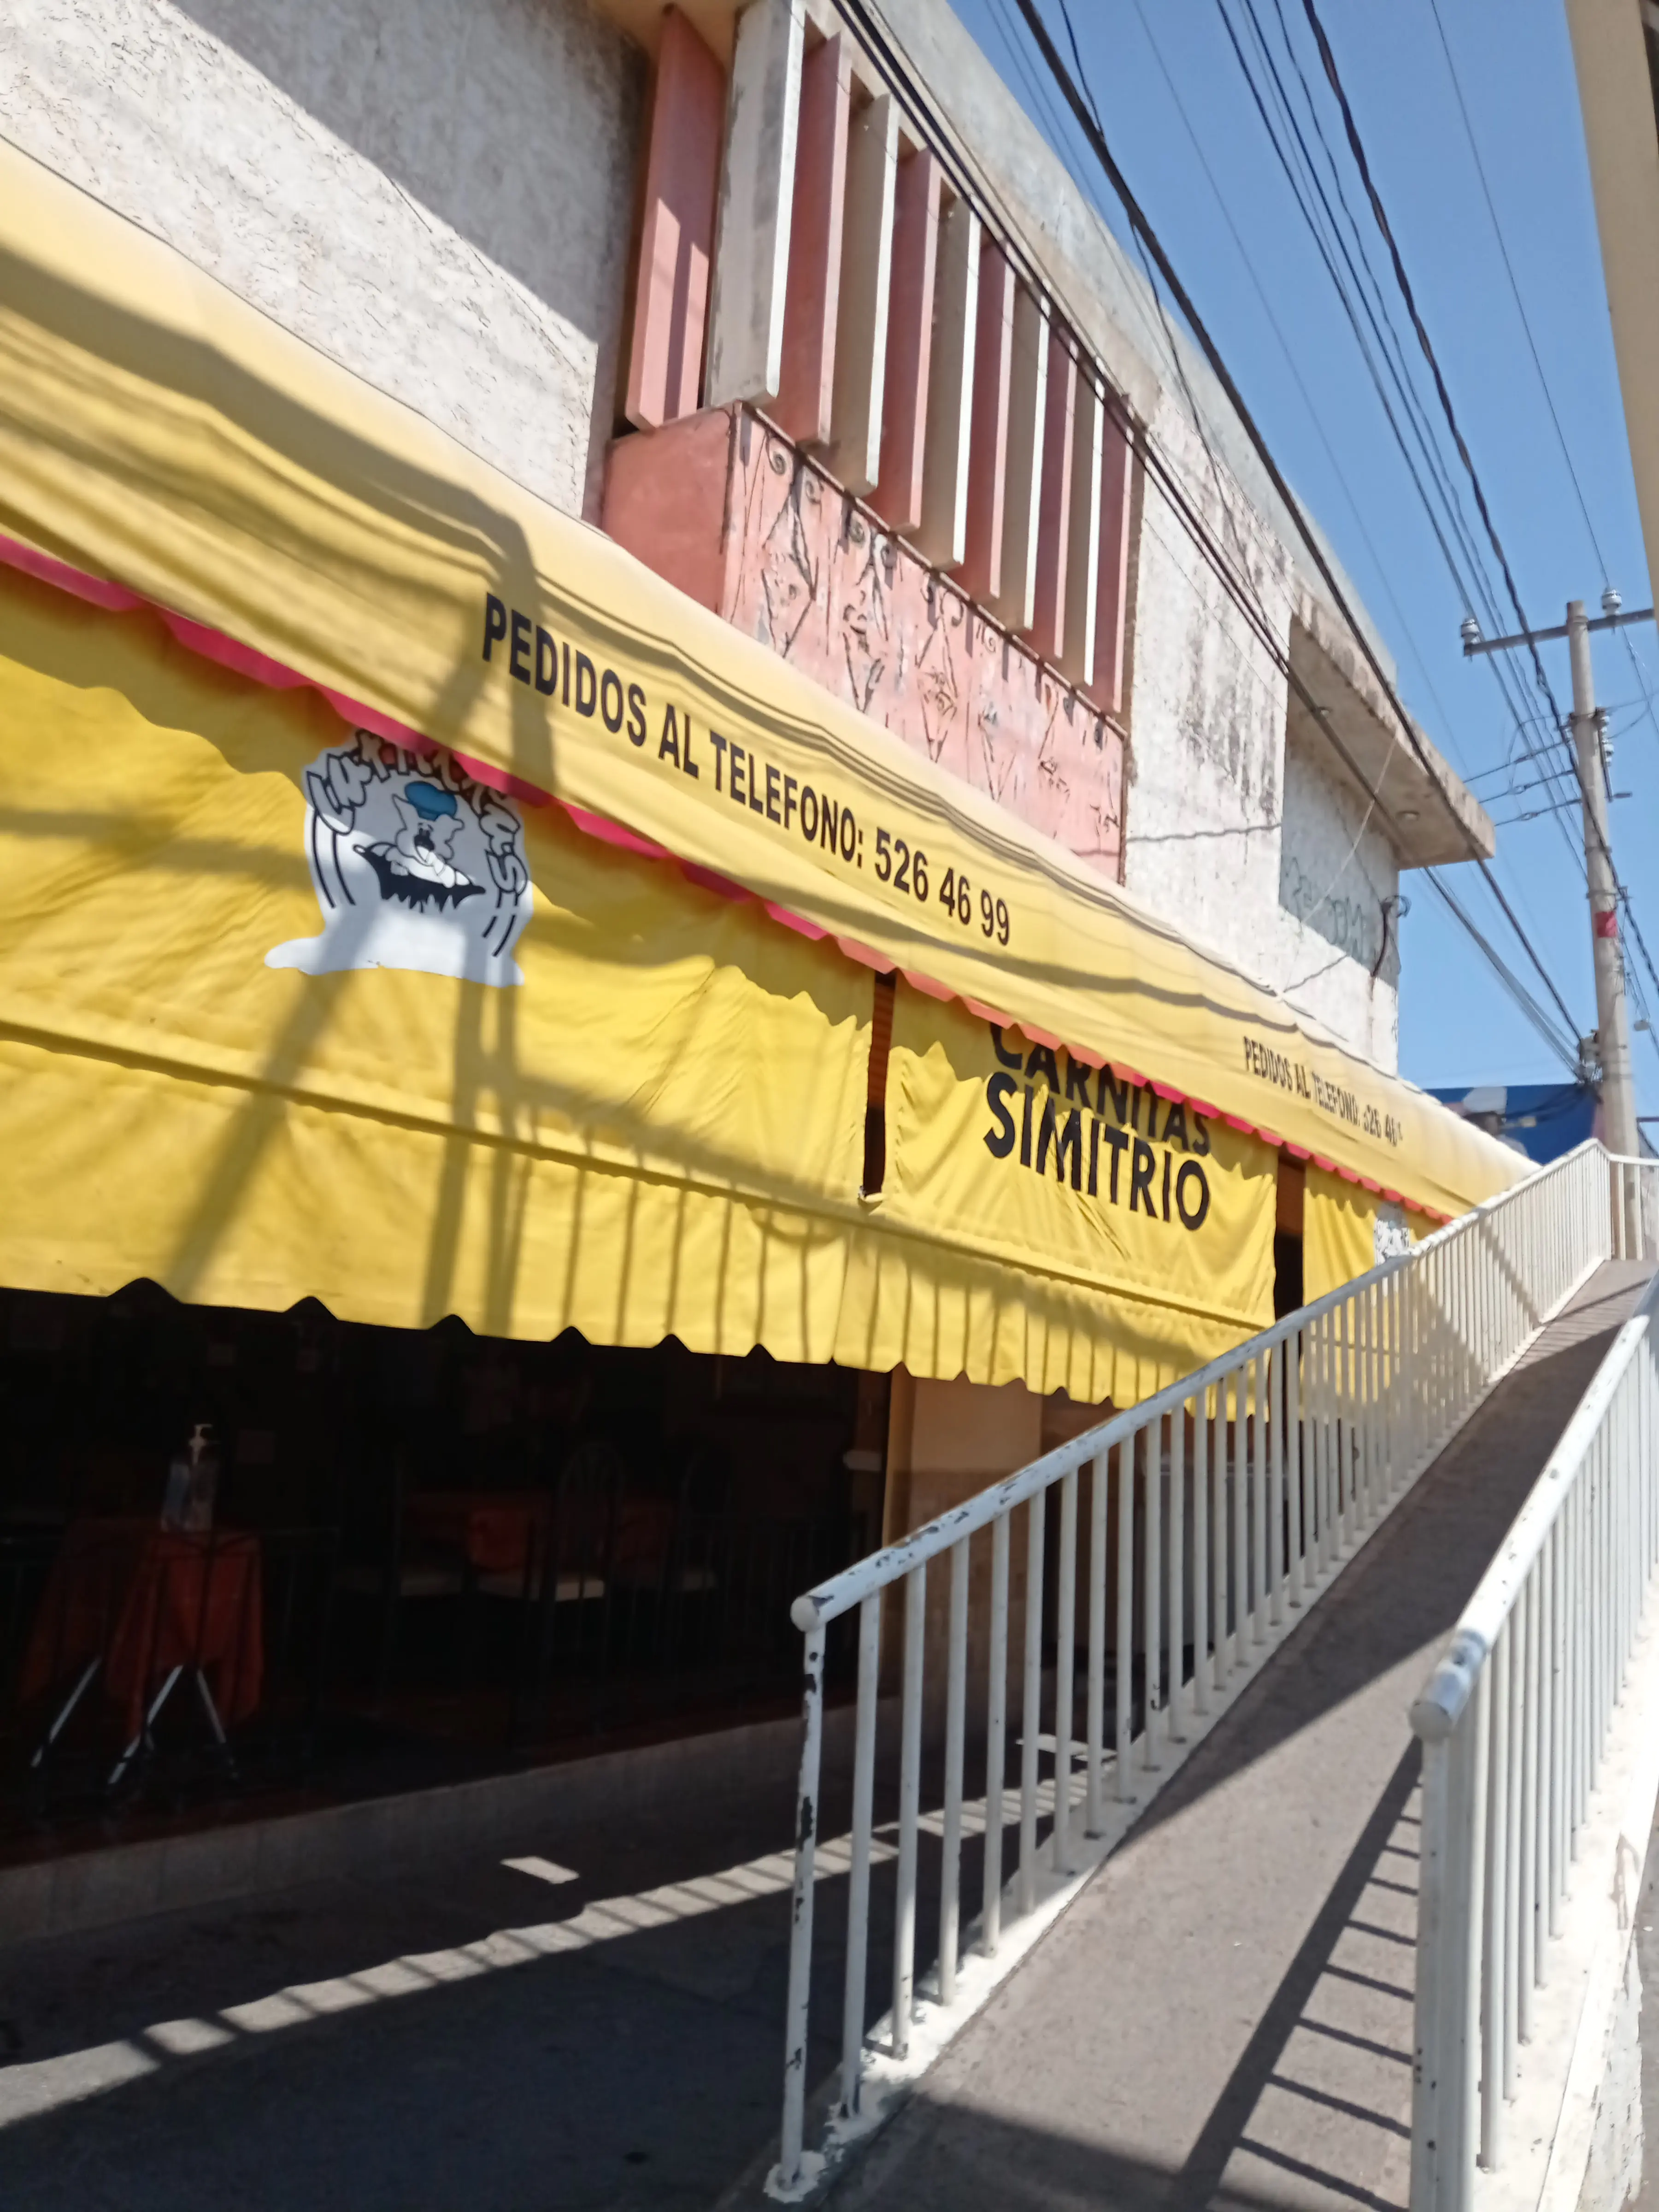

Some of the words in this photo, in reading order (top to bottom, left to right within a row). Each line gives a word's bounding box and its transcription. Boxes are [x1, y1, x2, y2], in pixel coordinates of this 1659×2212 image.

[482, 592, 647, 747] PEDIDOS
[658, 703, 699, 780] AL
[710, 729, 863, 868] TELEFONO:
[875, 827, 929, 902] 526
[939, 867, 971, 925] 46
[980, 889, 1010, 946] 99
[989, 1023, 1211, 1157] CARNITAS
[1244, 1035, 1293, 1091] PEDIDOS
[1294, 1063, 1311, 1100] AL
[983, 1071, 1211, 1231] SIMITRIO
